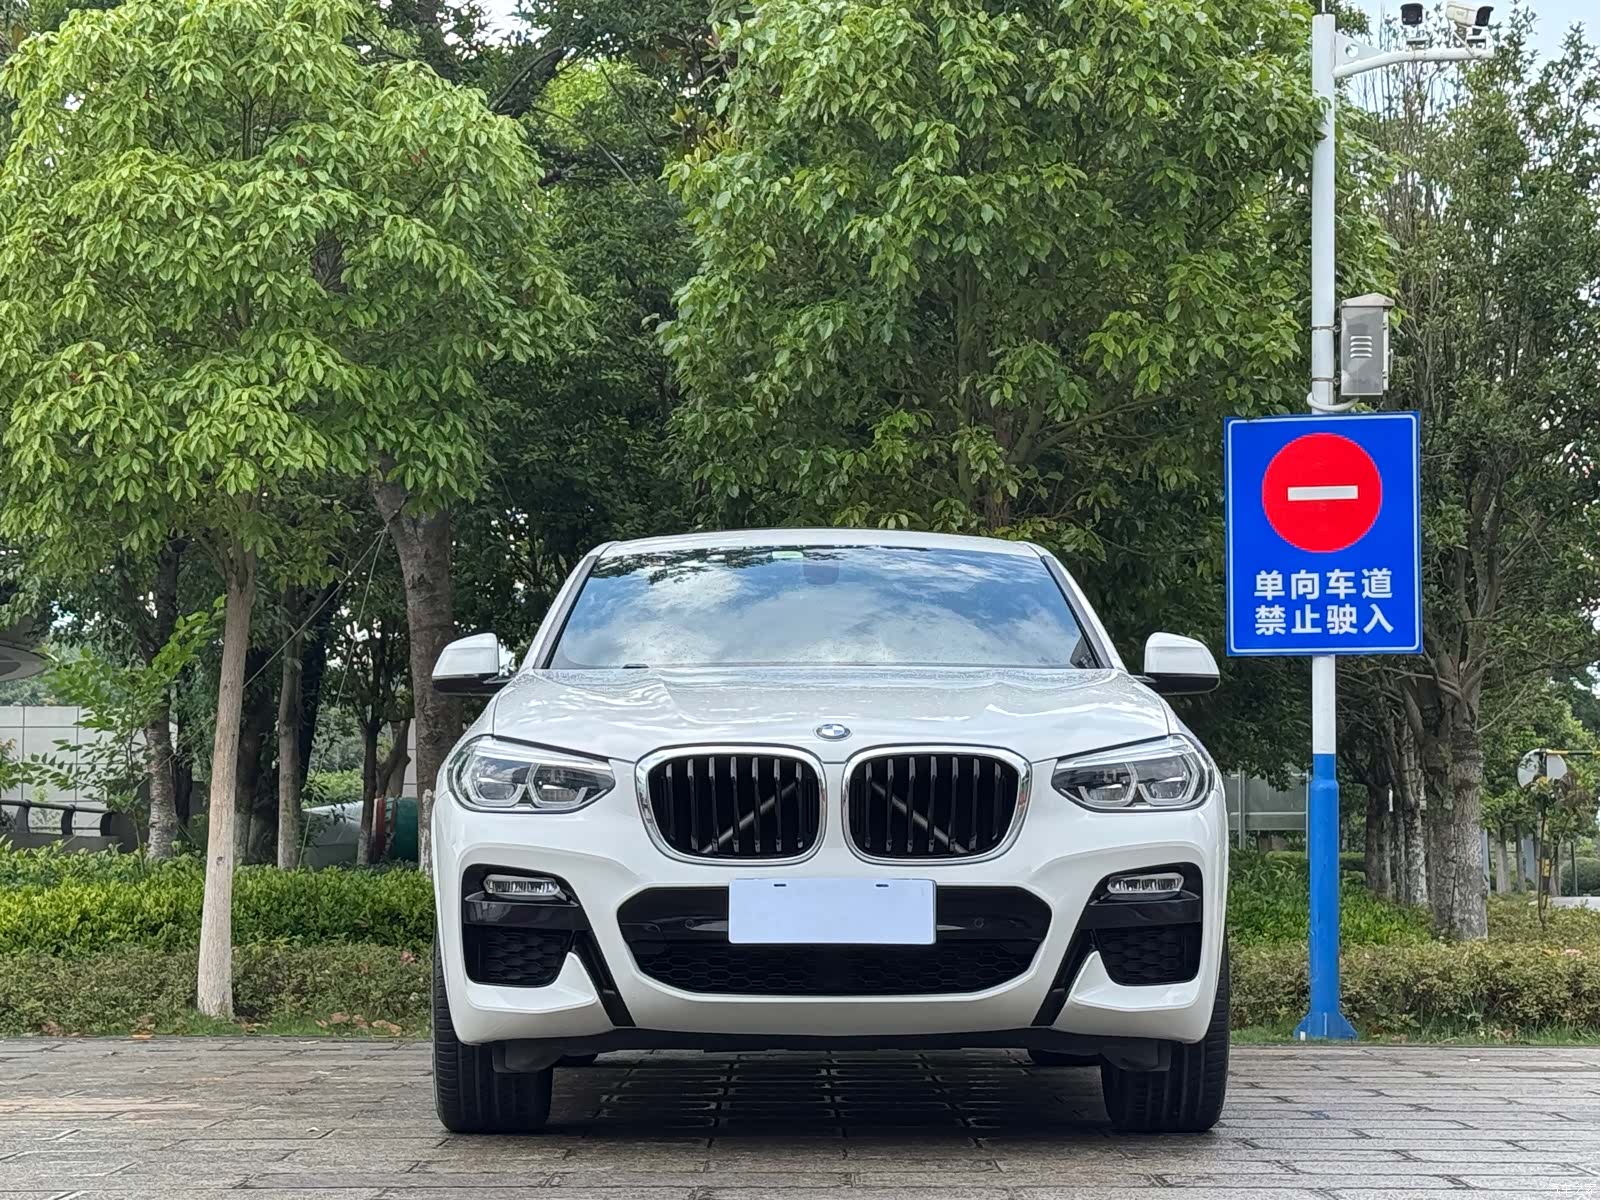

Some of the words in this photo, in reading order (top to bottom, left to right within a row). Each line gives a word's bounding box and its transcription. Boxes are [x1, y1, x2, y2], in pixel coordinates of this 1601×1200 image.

[1254, 568, 1393, 600] 单向车道
[1255, 604, 1394, 635] 禁止驶入
